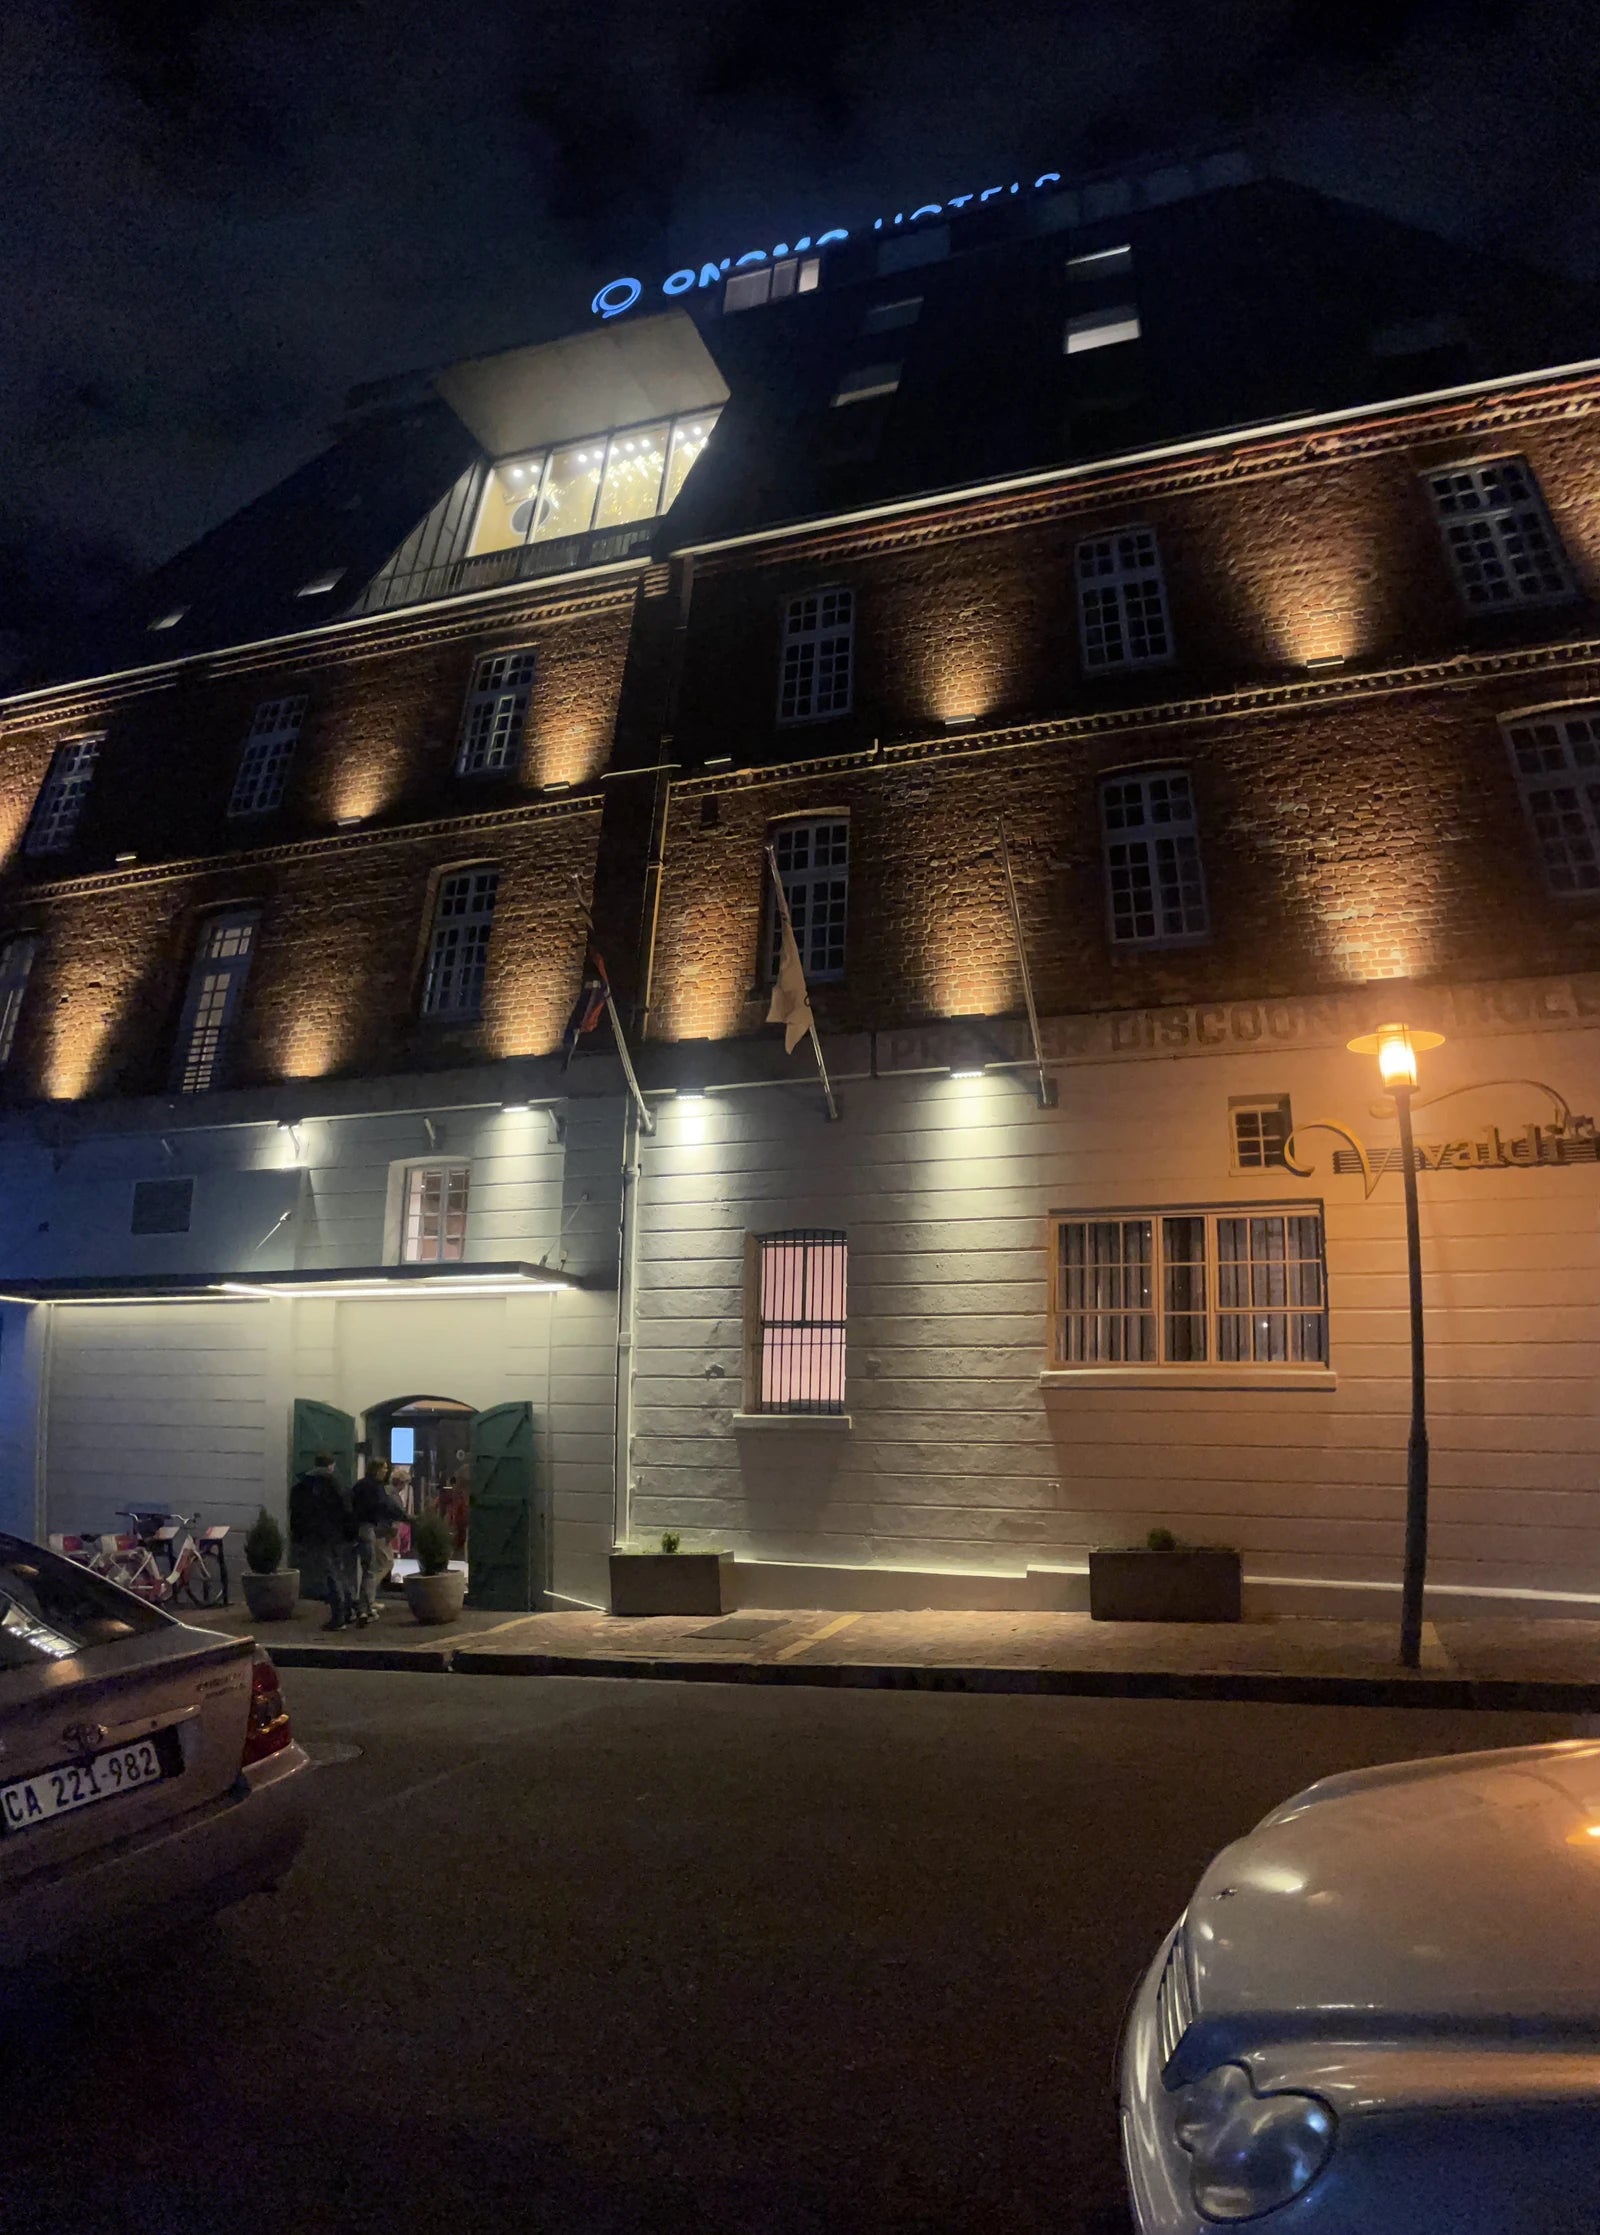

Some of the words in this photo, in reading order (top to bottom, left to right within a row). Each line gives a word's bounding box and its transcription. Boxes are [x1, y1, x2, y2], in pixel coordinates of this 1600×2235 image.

[1284, 1116, 1562, 1200] Vvaldi
[4, 1786, 42, 1822] CA
[52, 1748, 157, 1807] 221-982
